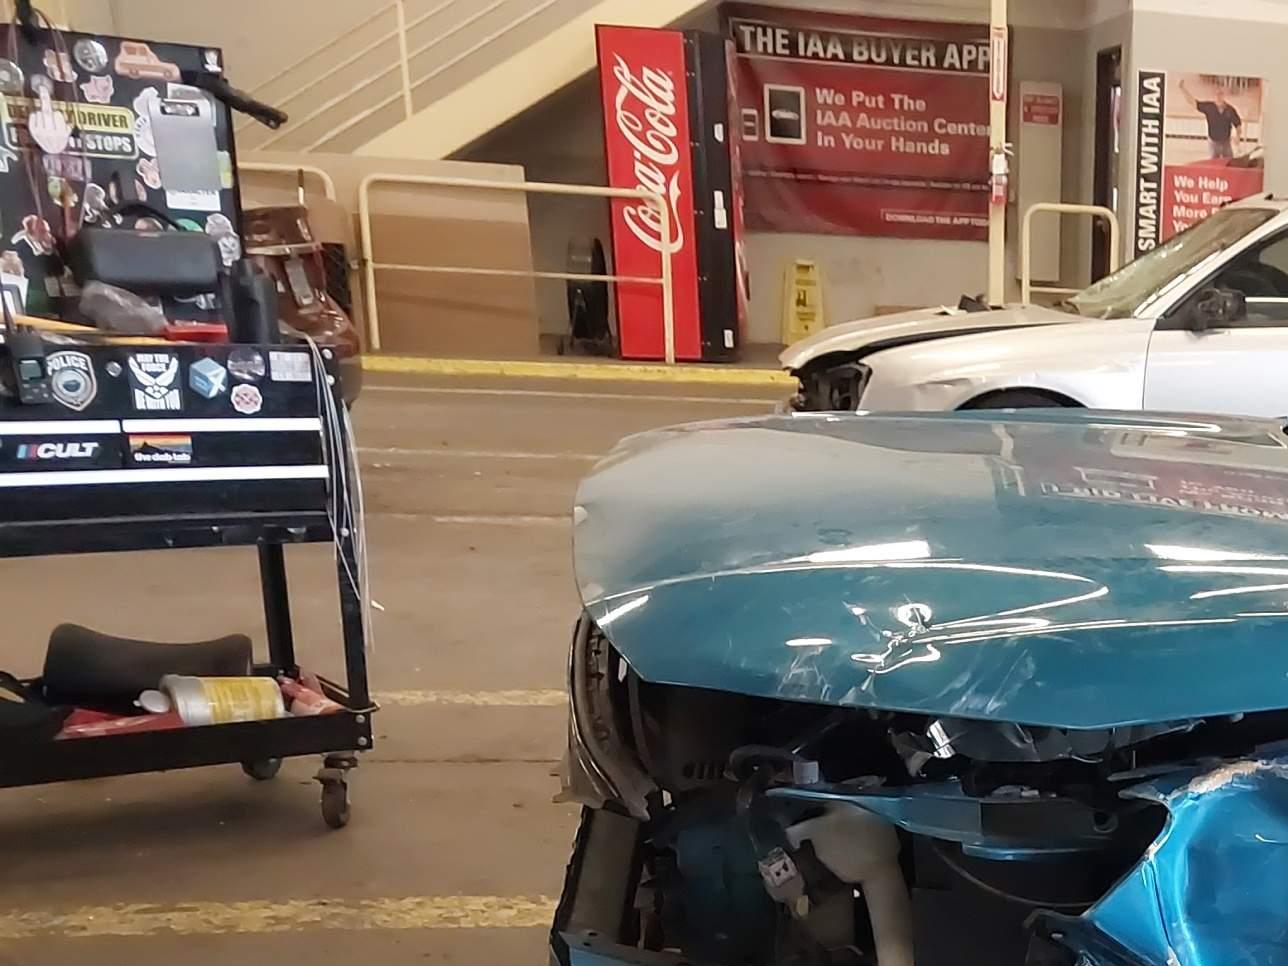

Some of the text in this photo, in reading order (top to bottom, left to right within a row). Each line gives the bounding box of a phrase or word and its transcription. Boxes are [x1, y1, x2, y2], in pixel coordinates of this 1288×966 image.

[740, 25, 790, 55] THE
[798, 32, 845, 60] IAA
[853, 36, 936, 67] BUYER
[943, 43, 990, 70] APP
[815, 87, 926, 112] We Put The
[79, 111, 128, 129] DRIVER
[816, 111, 852, 128] IAA
[857, 113, 928, 133] Auction
[86, 134, 132, 153] STOPS
[816, 131, 950, 156] In Your Hands
[1138, 76, 1161, 251] SMART WITH IAA
[1173, 175, 1229, 193] We Help
[1173, 190, 1199, 204] You
[935, 216, 951, 225] THE
[1172, 205, 1208, 219] More
[47, 355, 89, 376] POLICE
[37, 442, 99, 459] CULT
